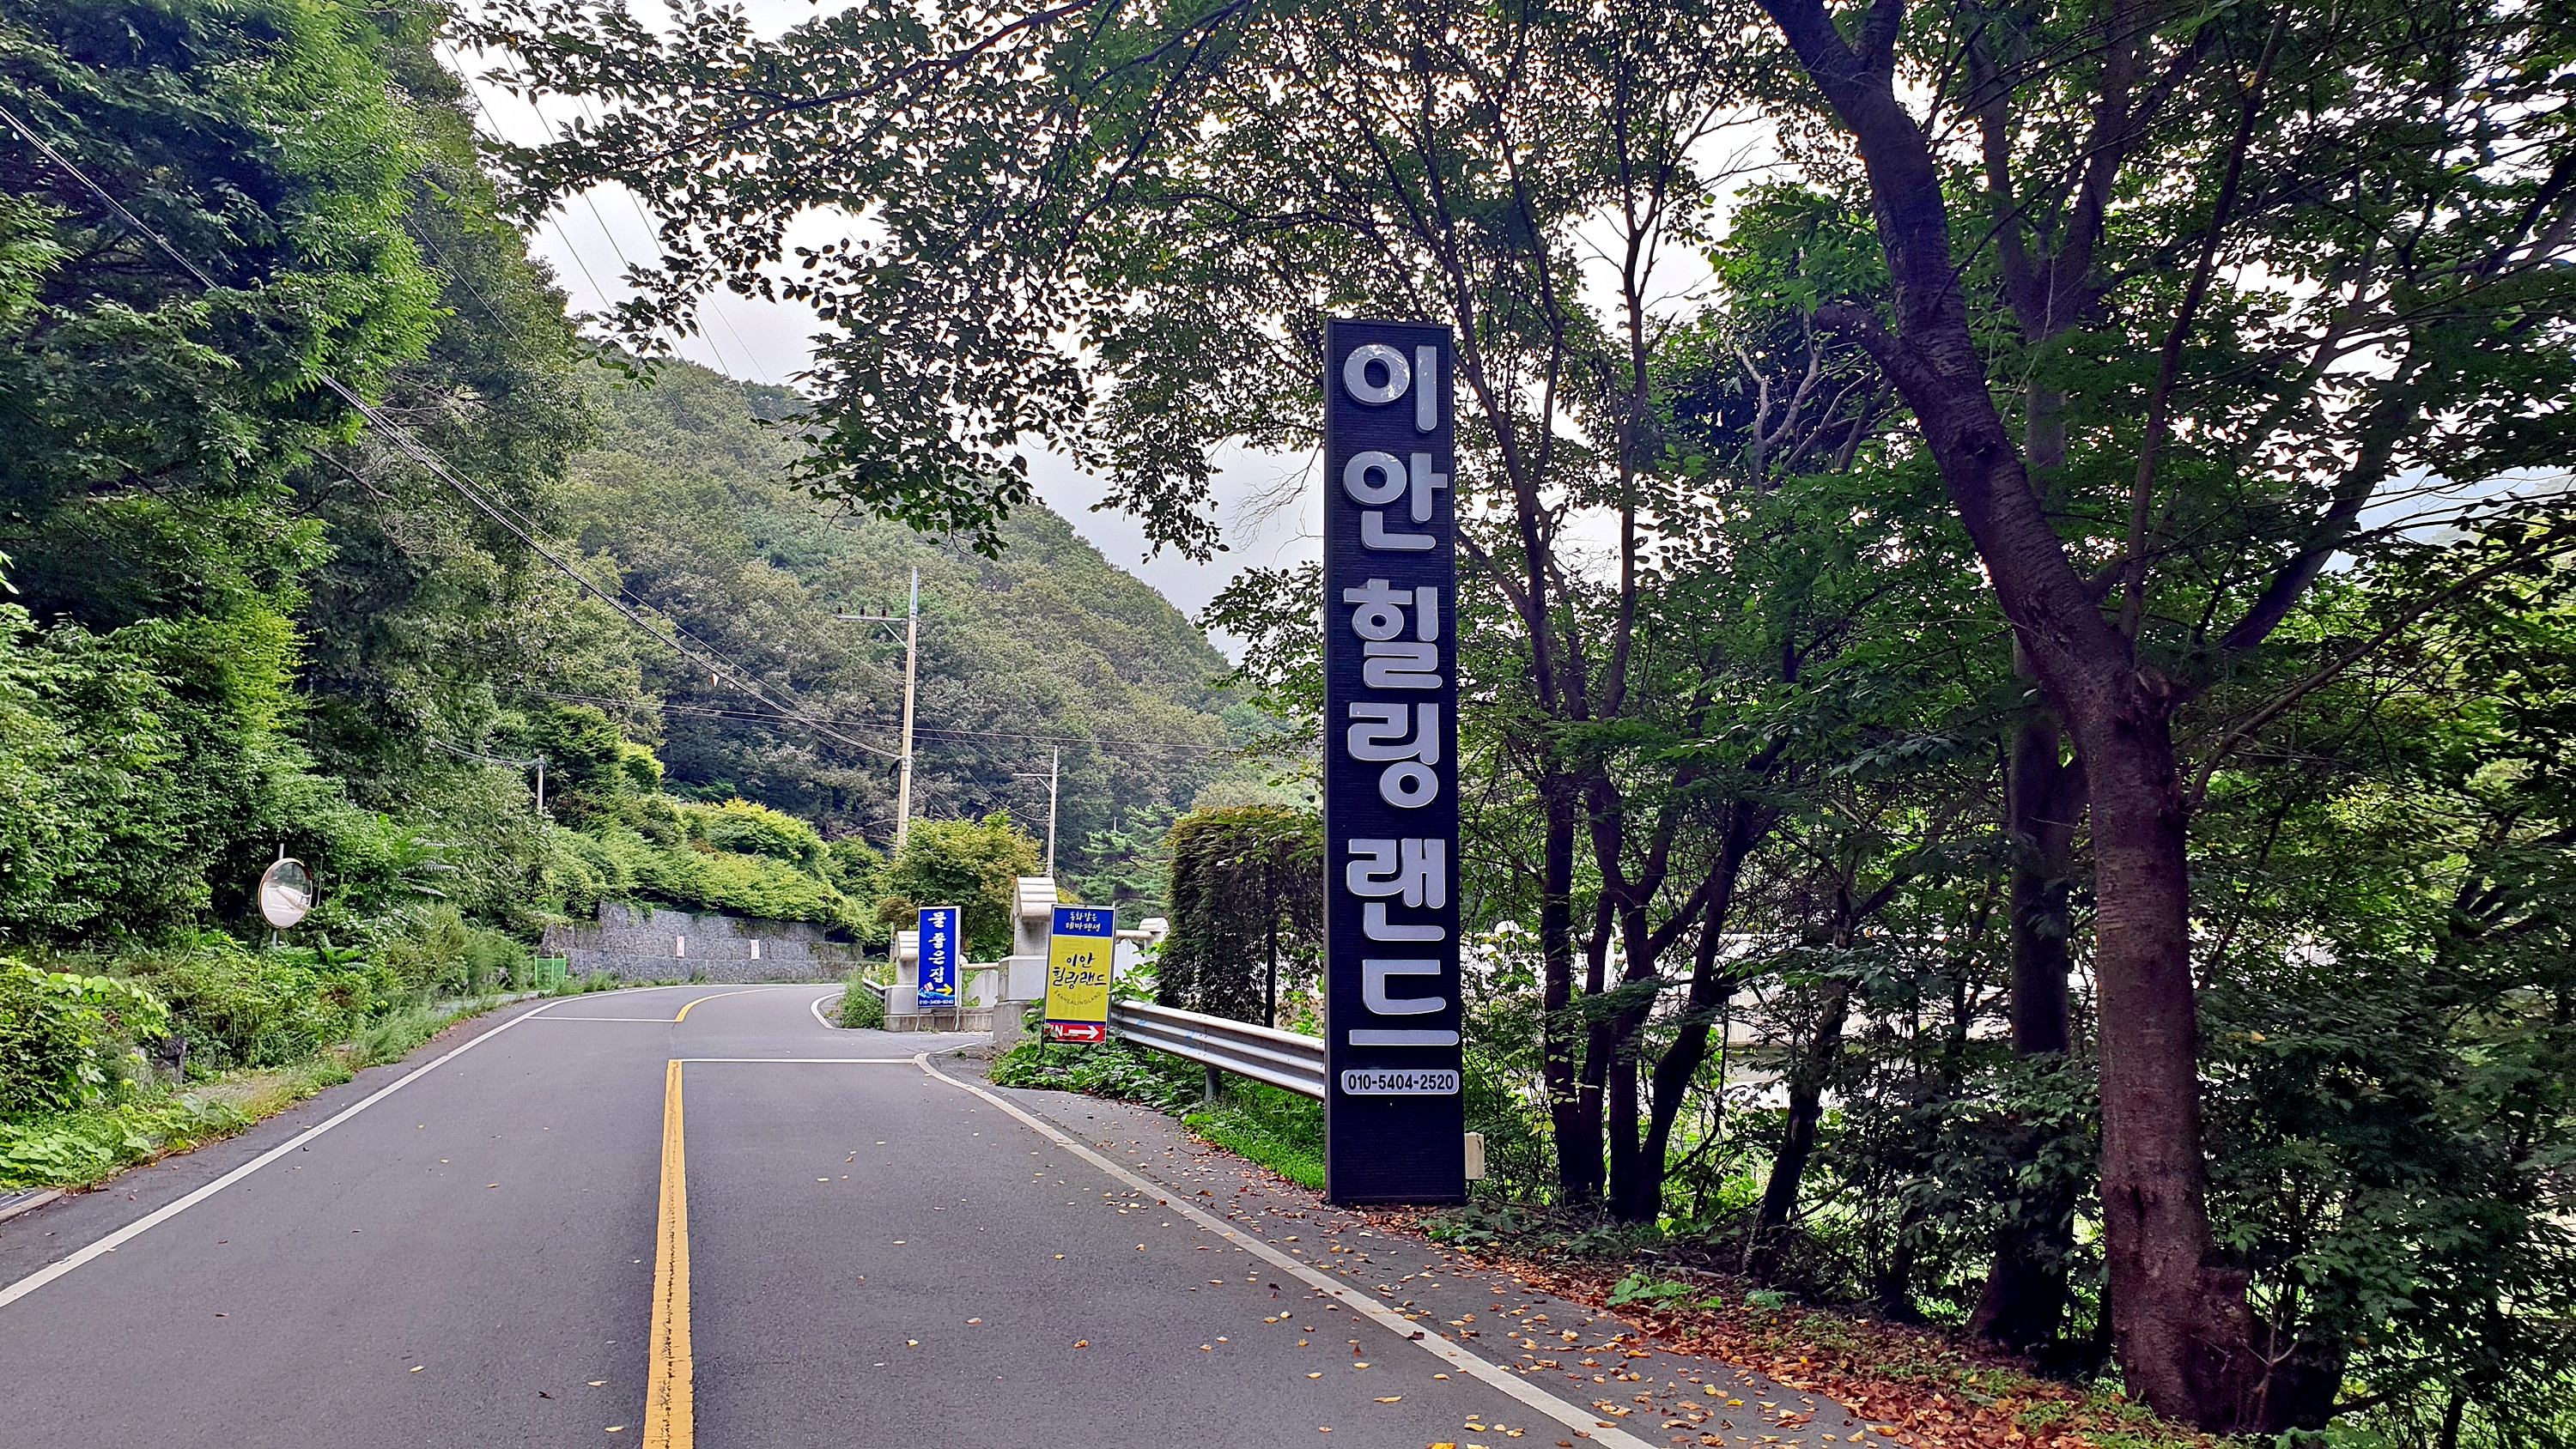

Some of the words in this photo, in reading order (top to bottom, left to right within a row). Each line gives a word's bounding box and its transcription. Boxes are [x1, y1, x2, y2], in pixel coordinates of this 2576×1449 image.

[928, 911, 947, 929] 물
[928, 932, 946, 966] 좋은
[1066, 952, 1096, 968] 이안
[929, 967, 945, 984] 집
[1053, 967, 1107, 990] 힐링랜드
[1347, 1074, 1454, 1090] 010-5404-2520
